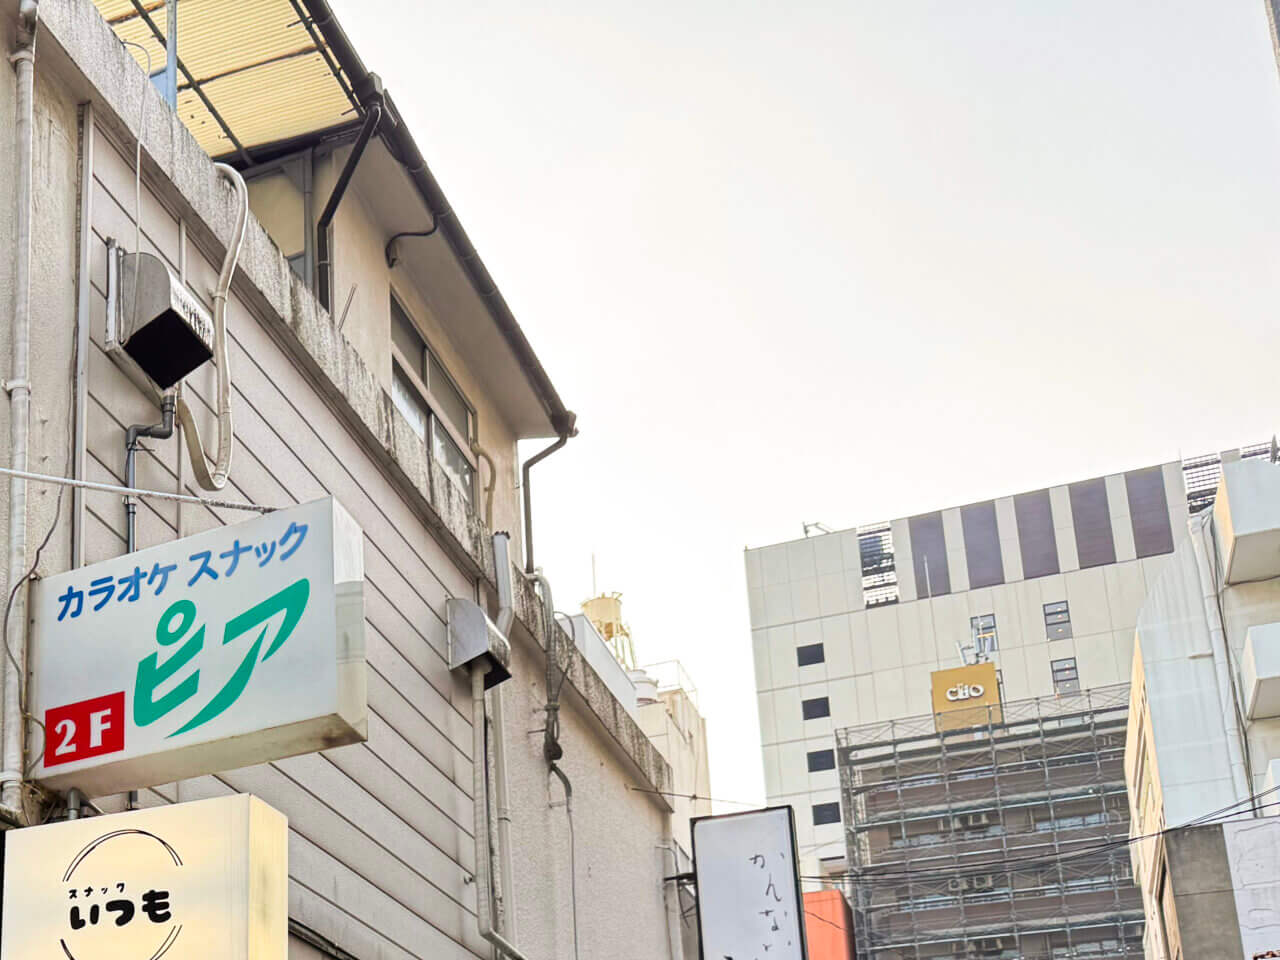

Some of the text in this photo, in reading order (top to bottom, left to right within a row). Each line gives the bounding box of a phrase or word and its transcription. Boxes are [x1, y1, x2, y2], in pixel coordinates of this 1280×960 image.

[57, 521, 309, 622] カラオケ スナック
[133, 577, 311, 739] ピア
[54, 707, 113, 757] 2F
[68, 882, 125, 900] スナック
[70, 889, 172, 931] いつも
